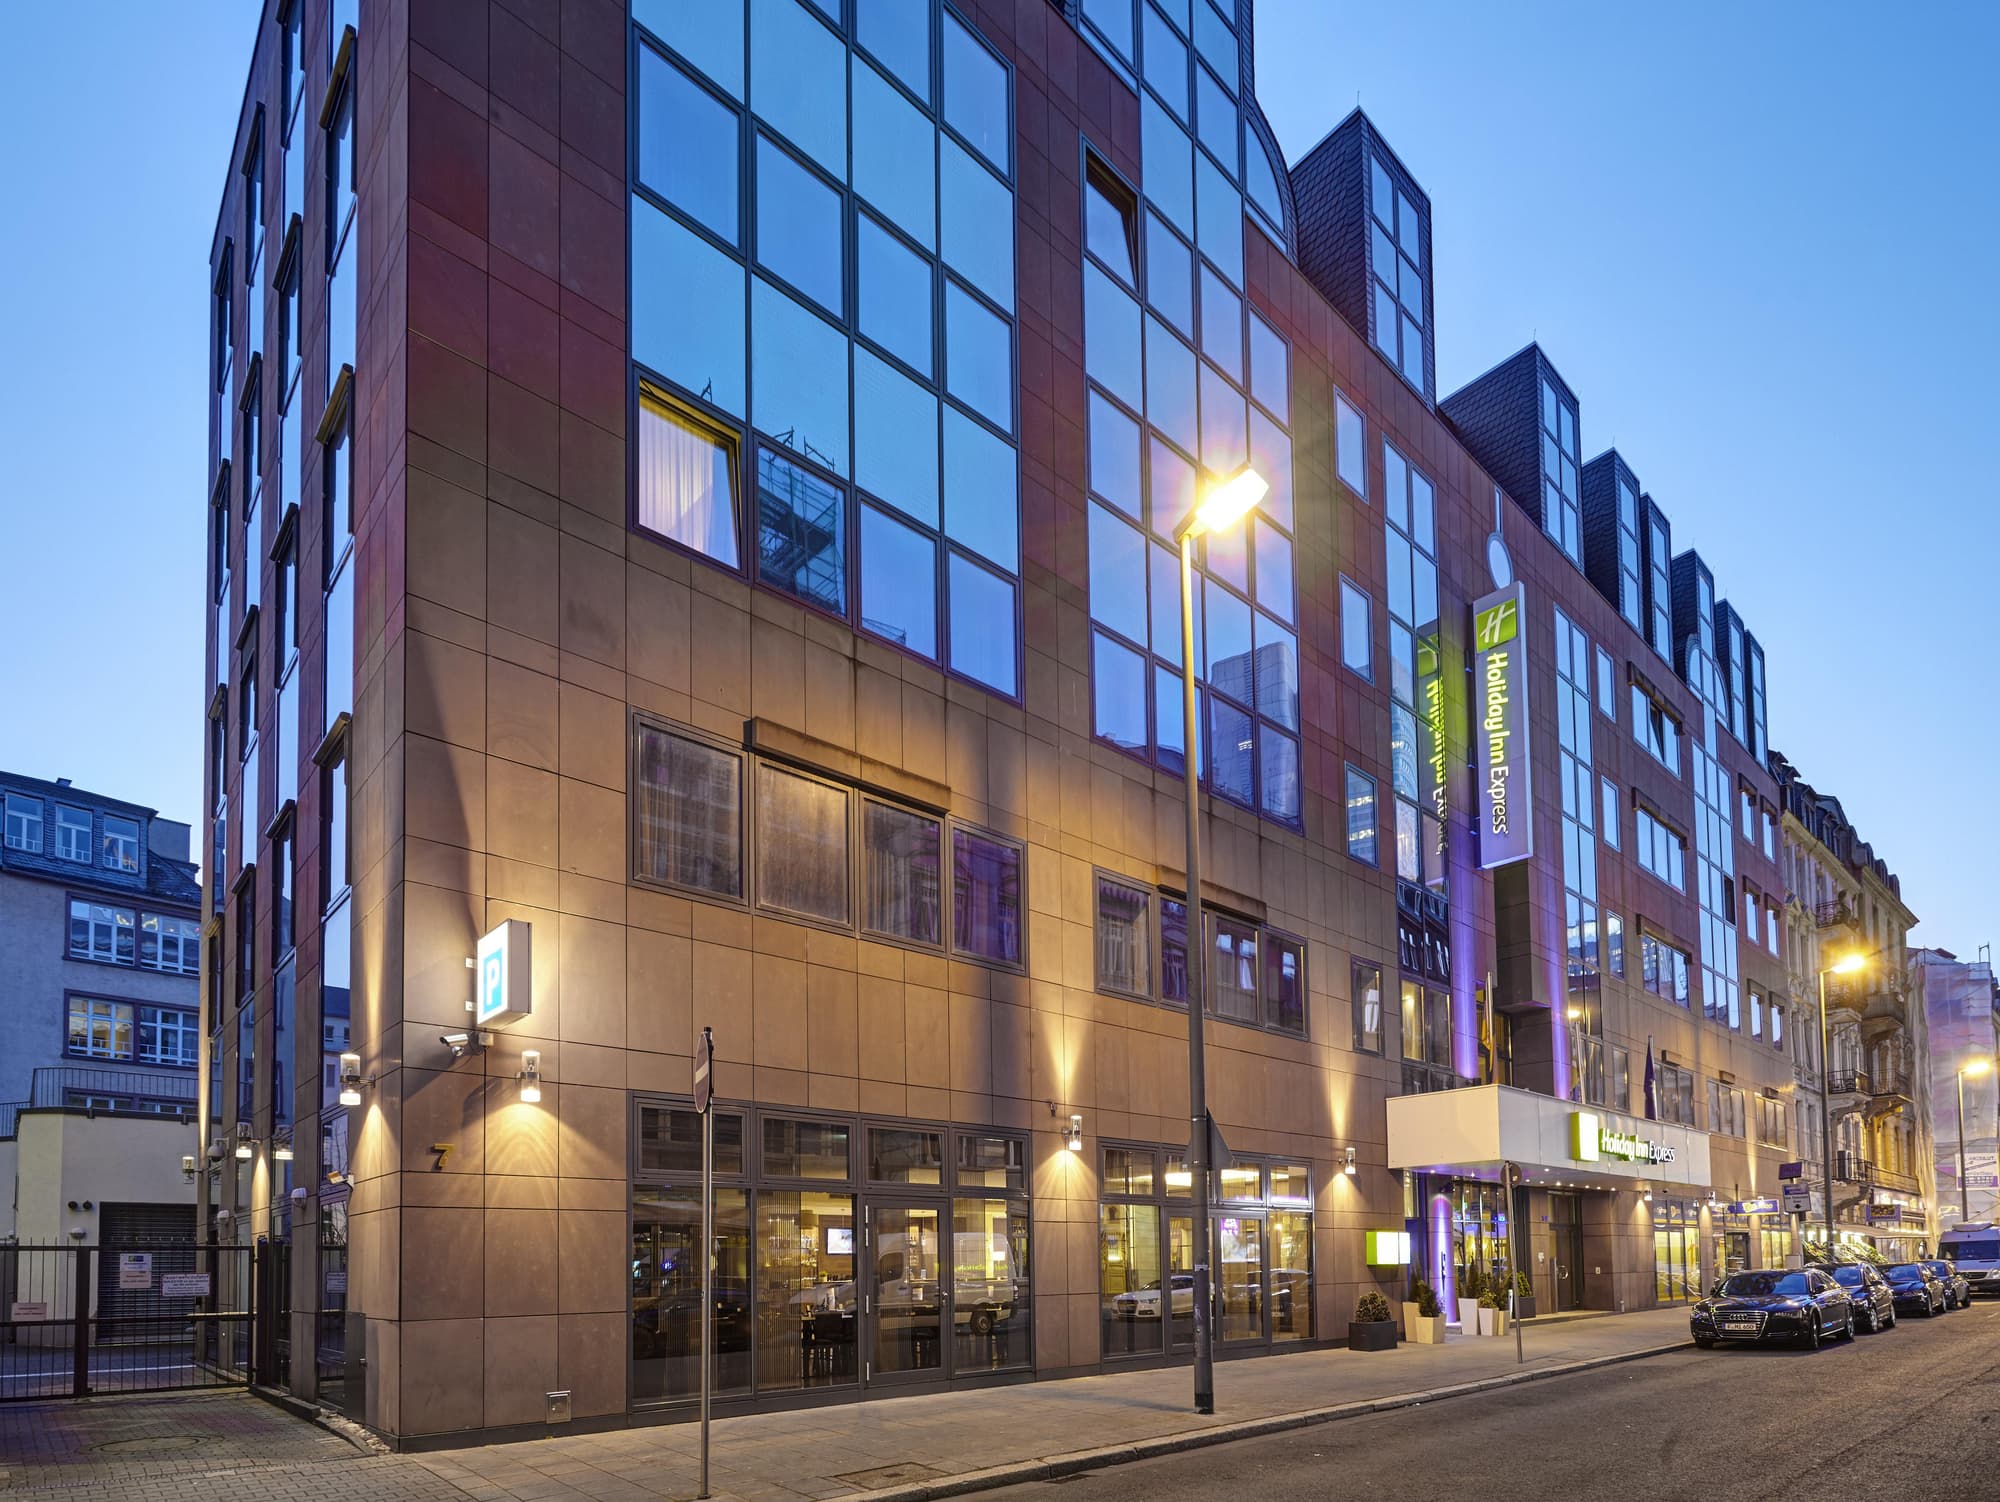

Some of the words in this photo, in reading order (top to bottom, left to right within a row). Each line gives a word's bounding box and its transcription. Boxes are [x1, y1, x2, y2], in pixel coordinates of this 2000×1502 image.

[1484, 652, 1509, 731] Holiday
[1488, 730, 1511, 764] Inn
[1487, 766, 1509, 835] Express
[486, 957, 500, 1006] P
[1602, 1127, 1636, 1162] Holiday
[1635, 1134, 1649, 1159] Inn
[1649, 1140, 1676, 1164] Express
